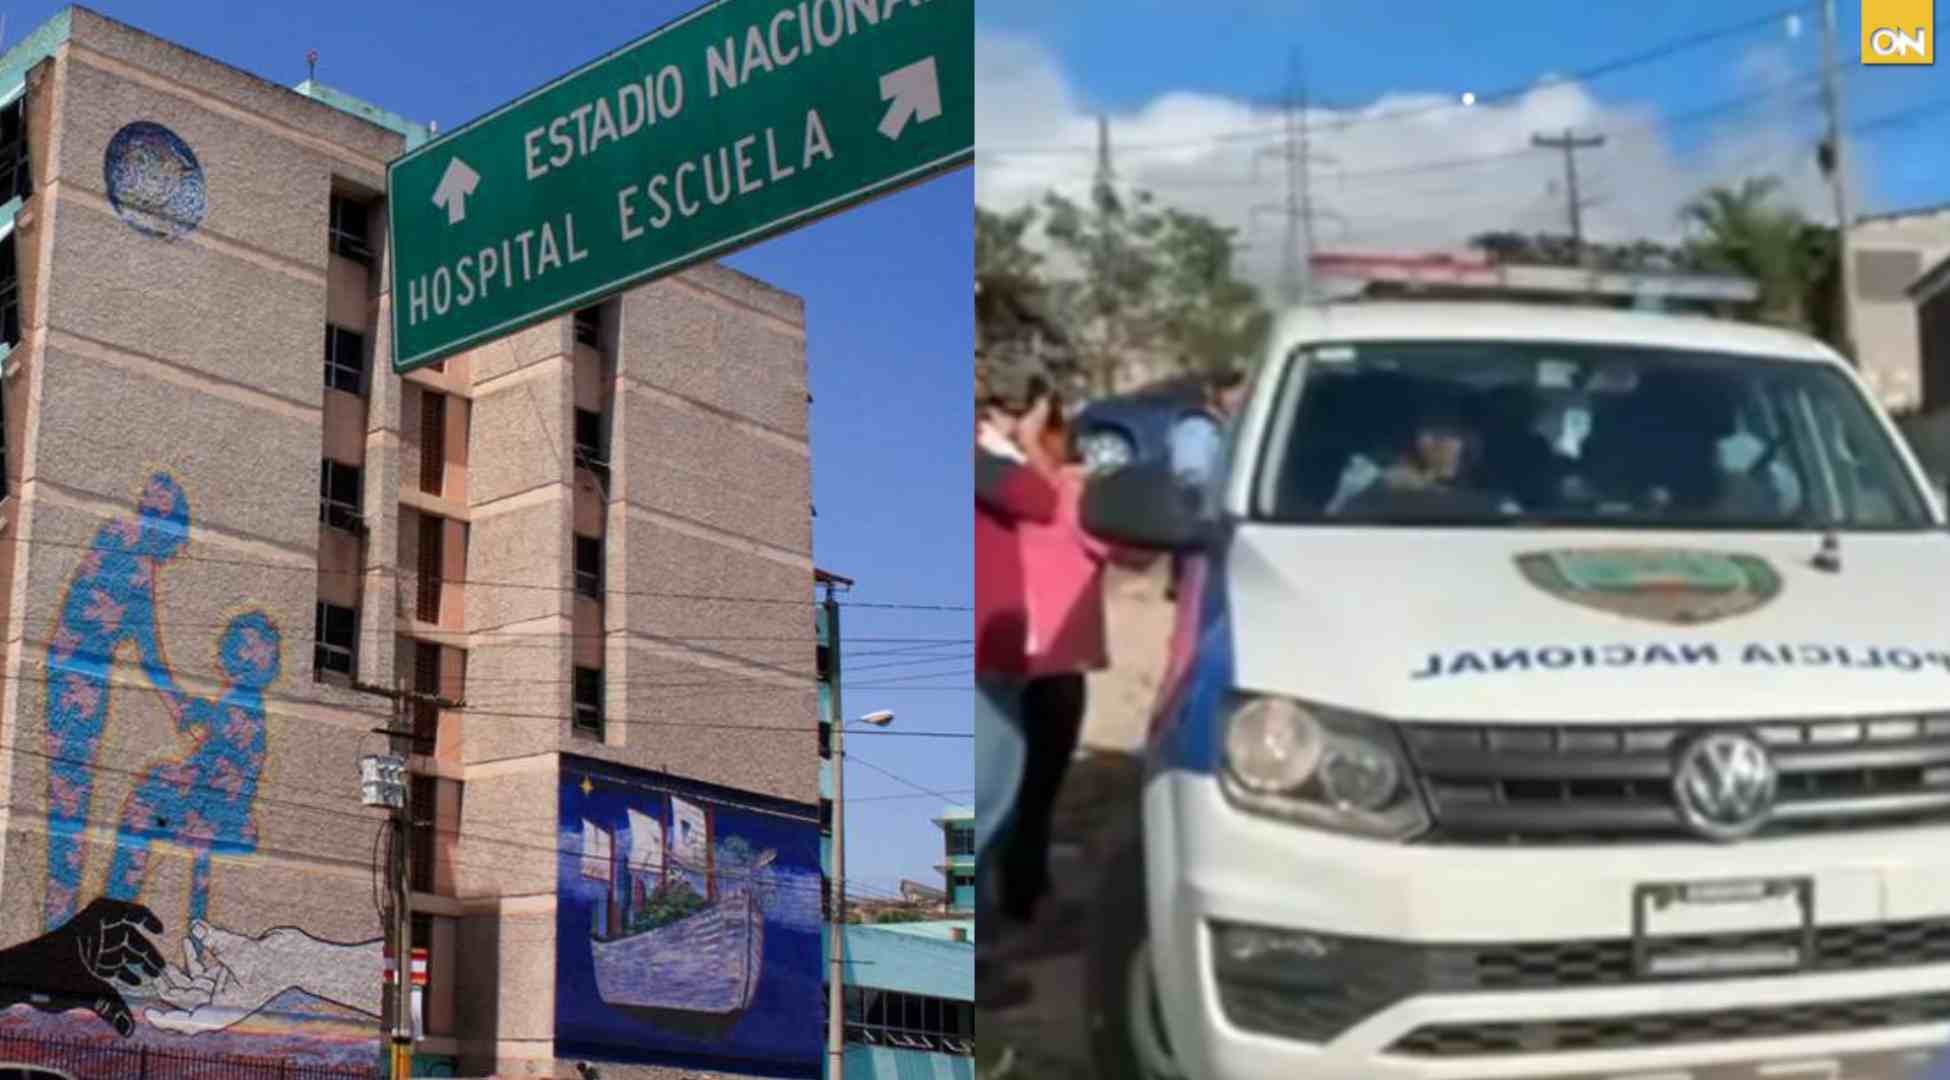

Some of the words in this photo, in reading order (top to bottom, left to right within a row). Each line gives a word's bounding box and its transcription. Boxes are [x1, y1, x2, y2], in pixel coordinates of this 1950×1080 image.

[524, 66, 684, 181] ESTADIO
[706, 0, 928, 97] NACION
[408, 213, 588, 326] HOSPITAL
[619, 109, 834, 241] ESCUELA
